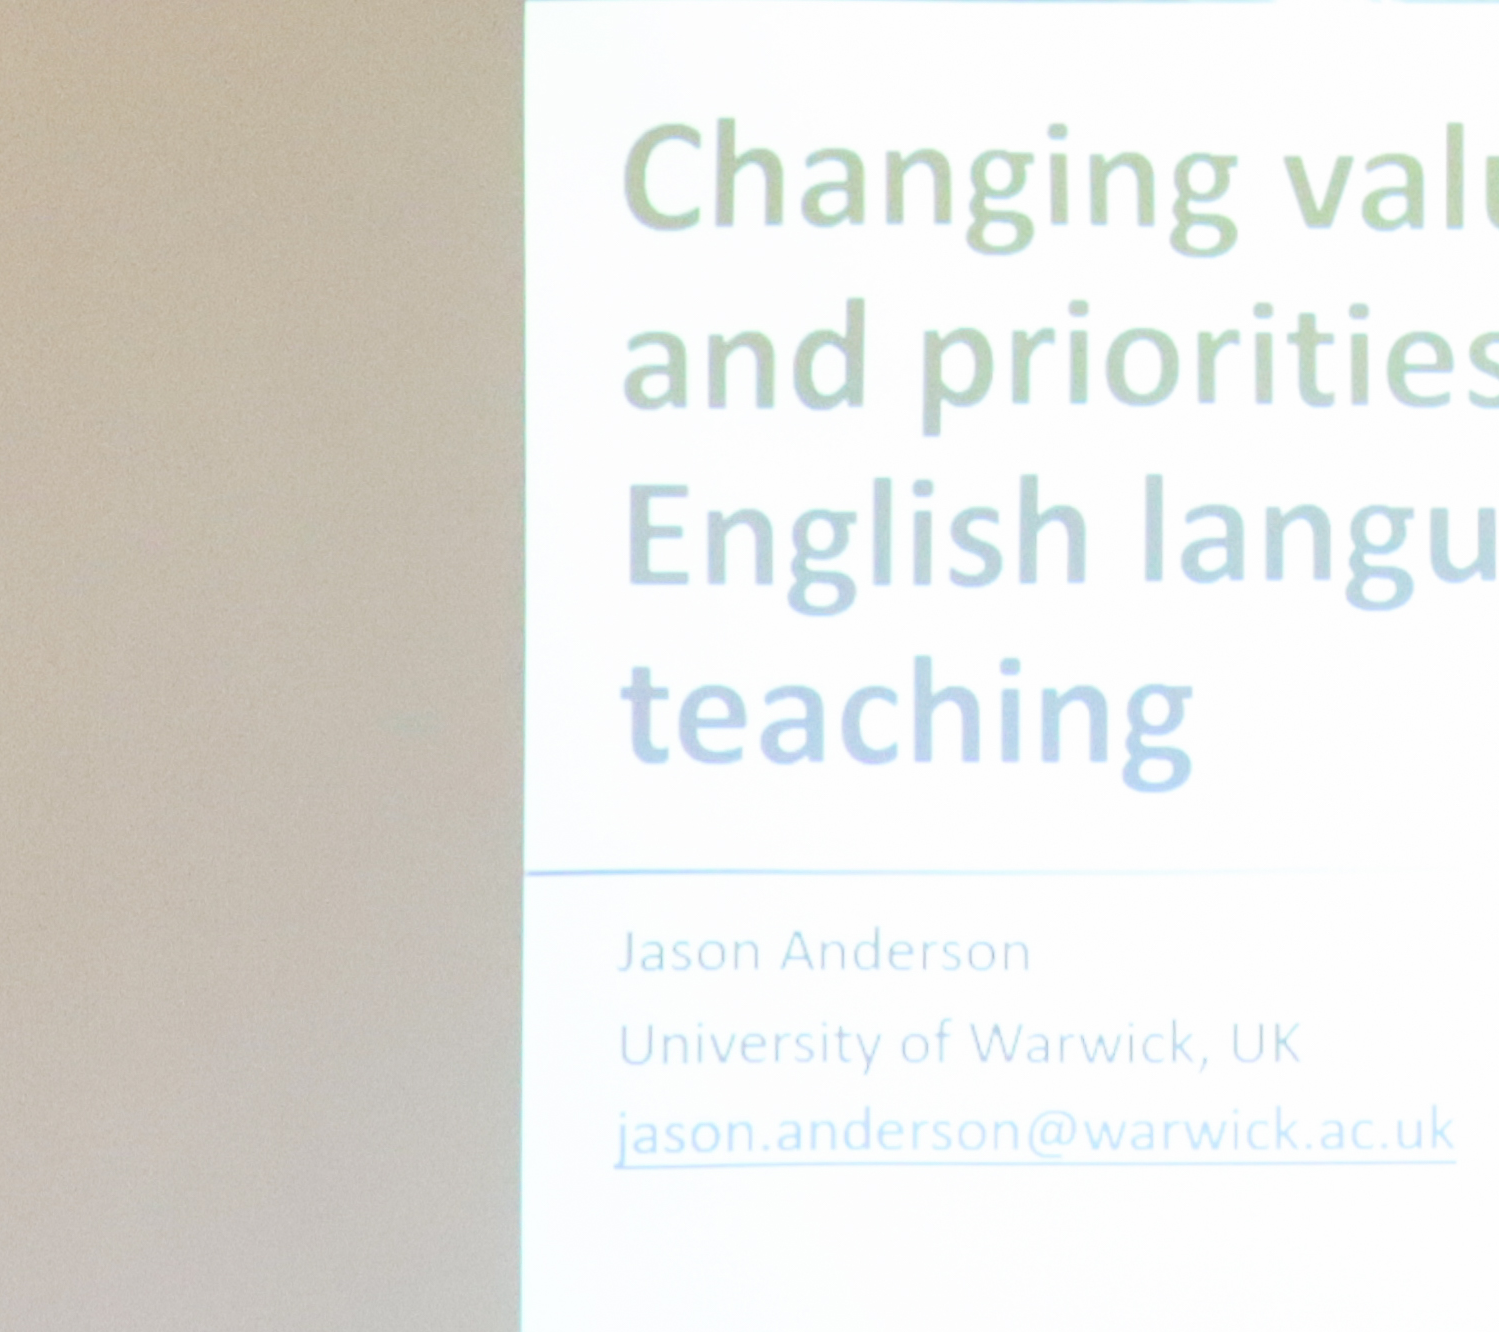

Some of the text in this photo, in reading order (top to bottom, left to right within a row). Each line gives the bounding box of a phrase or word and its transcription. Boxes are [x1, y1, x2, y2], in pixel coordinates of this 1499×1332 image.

[621, 114, 1241, 261] Changing
[621, 294, 868, 413] and
[627, 471, 1089, 619] English
[618, 652, 1195, 795] teaching
[613, 923, 1032, 976] Jason Anderson
[617, 1014, 1303, 1078] University of Warwick, UK
[609, 1101, 1459, 1175] jason.anderson@warwick.ac.uk
